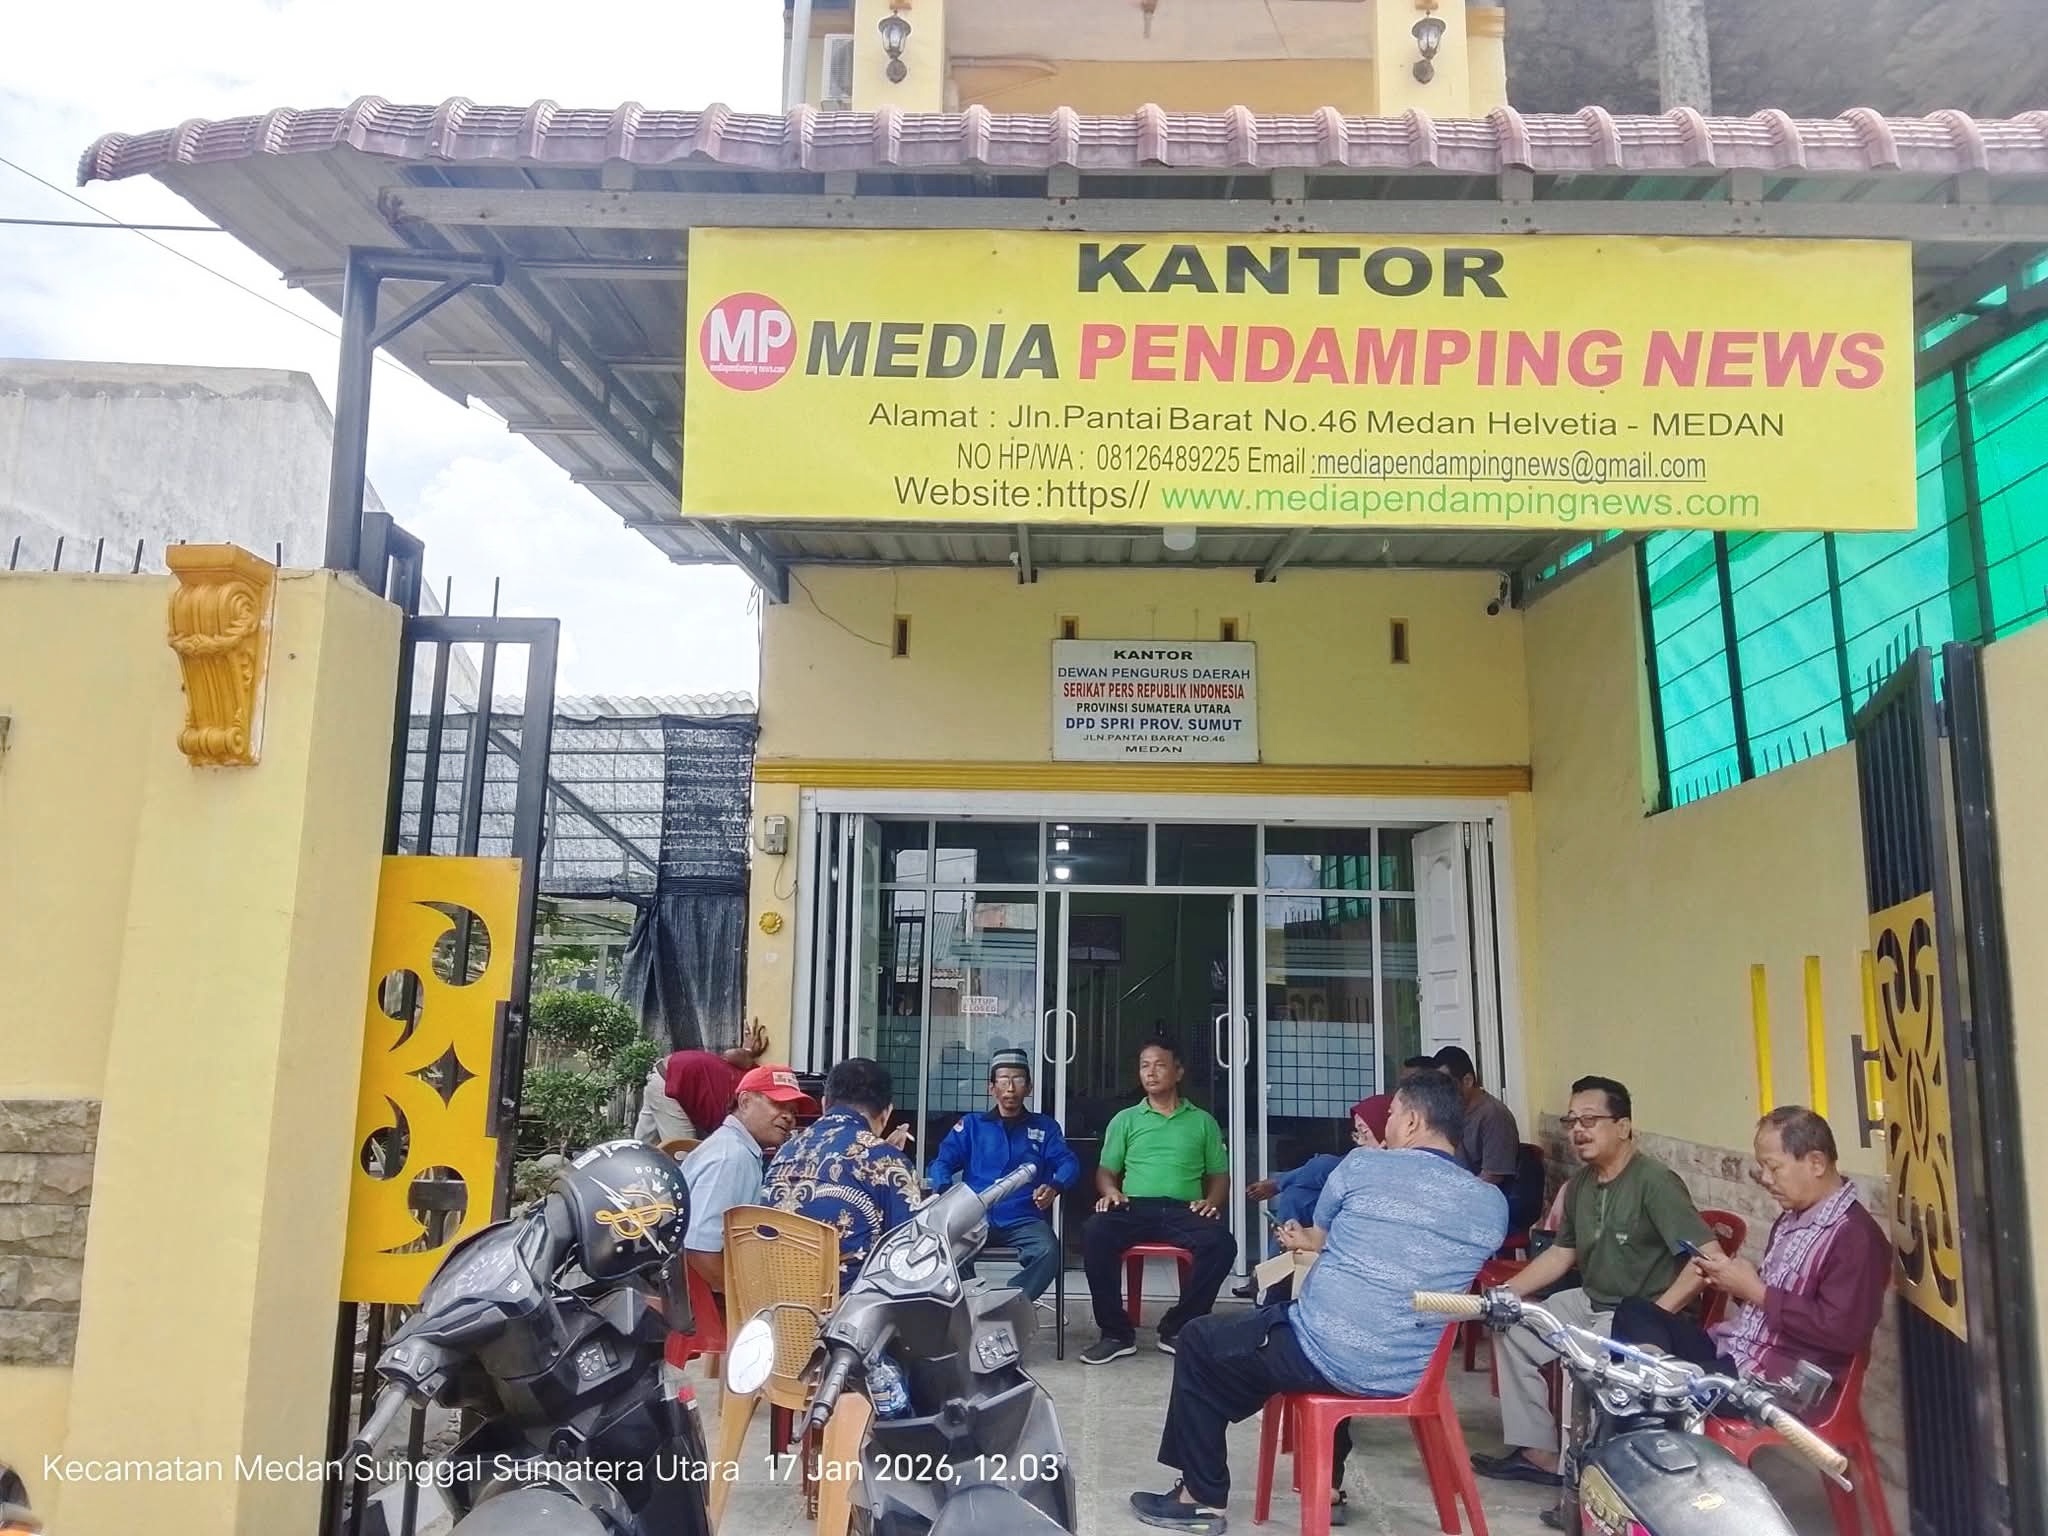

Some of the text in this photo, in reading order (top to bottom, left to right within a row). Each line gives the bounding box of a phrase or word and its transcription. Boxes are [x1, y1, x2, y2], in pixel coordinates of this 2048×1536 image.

[1078, 243, 1508, 298] KANTOR
[709, 308, 792, 363] MP
[805, 321, 1884, 390] MEDIA PENDAMPING NEWS
[868, 402, 978, 428] Alamat
[1008, 404, 1162, 430] Jln.Pantai
[1169, 407, 1252, 432] Barat
[1264, 408, 1357, 433] No.46
[1367, 410, 1475, 435] Medan
[1489, 411, 1617, 436] Helvetia
[1653, 412, 1784, 437] MEDAN
[957, 442, 991, 470] NO
[1097, 444, 1240, 472] 08126489225
[1248, 446, 1305, 475] Email
[1161, 483, 1760, 522] www.mediapendampingnews.com
[1114, 650, 1193, 660] KANTOR
[1058, 667, 1250, 680] DEWAN PENGURUS DAERAH
[1063, 682, 1245, 699] SERIKAT PERS REPUBLIK INDONESIA
[1076, 702, 1231, 714] PROVINSI SUMATERA UTARA
[1066, 717, 1242, 731] DPD SPRI PROV. SUMUT
[1125, 745, 1183, 753] MEDAN
[1192, 735, 1225, 743] NO.46
[634, 1166, 669, 1181] BORN
[673, 1182, 683, 1200] TO
